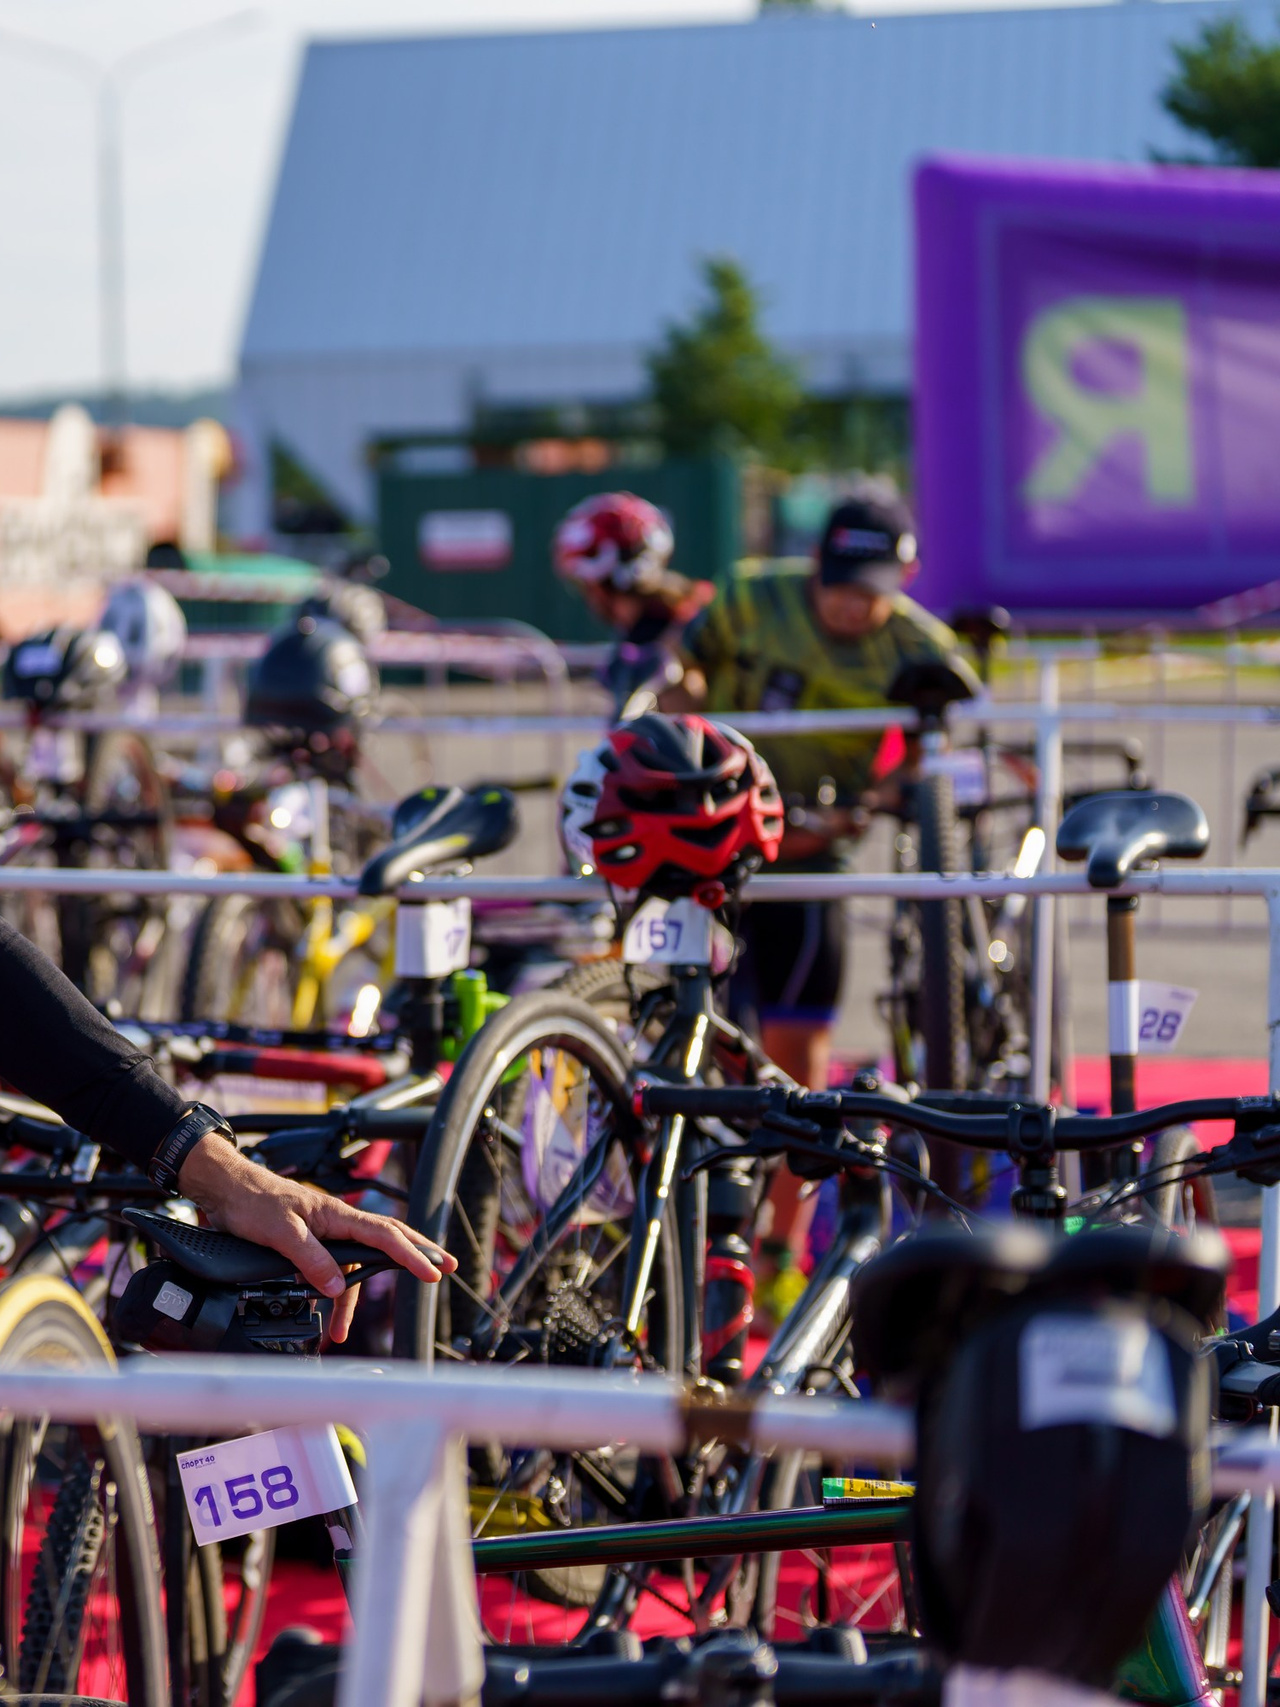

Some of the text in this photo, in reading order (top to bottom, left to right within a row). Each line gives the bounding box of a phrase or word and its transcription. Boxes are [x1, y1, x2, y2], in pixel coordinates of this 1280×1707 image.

[634, 918, 683, 953] 157
[1139, 1007, 1183, 1042] 28
[181, 1458, 204, 1470] СПОРТ
[204, 1455, 216, 1463] 40
[194, 1465, 299, 1528] 158
